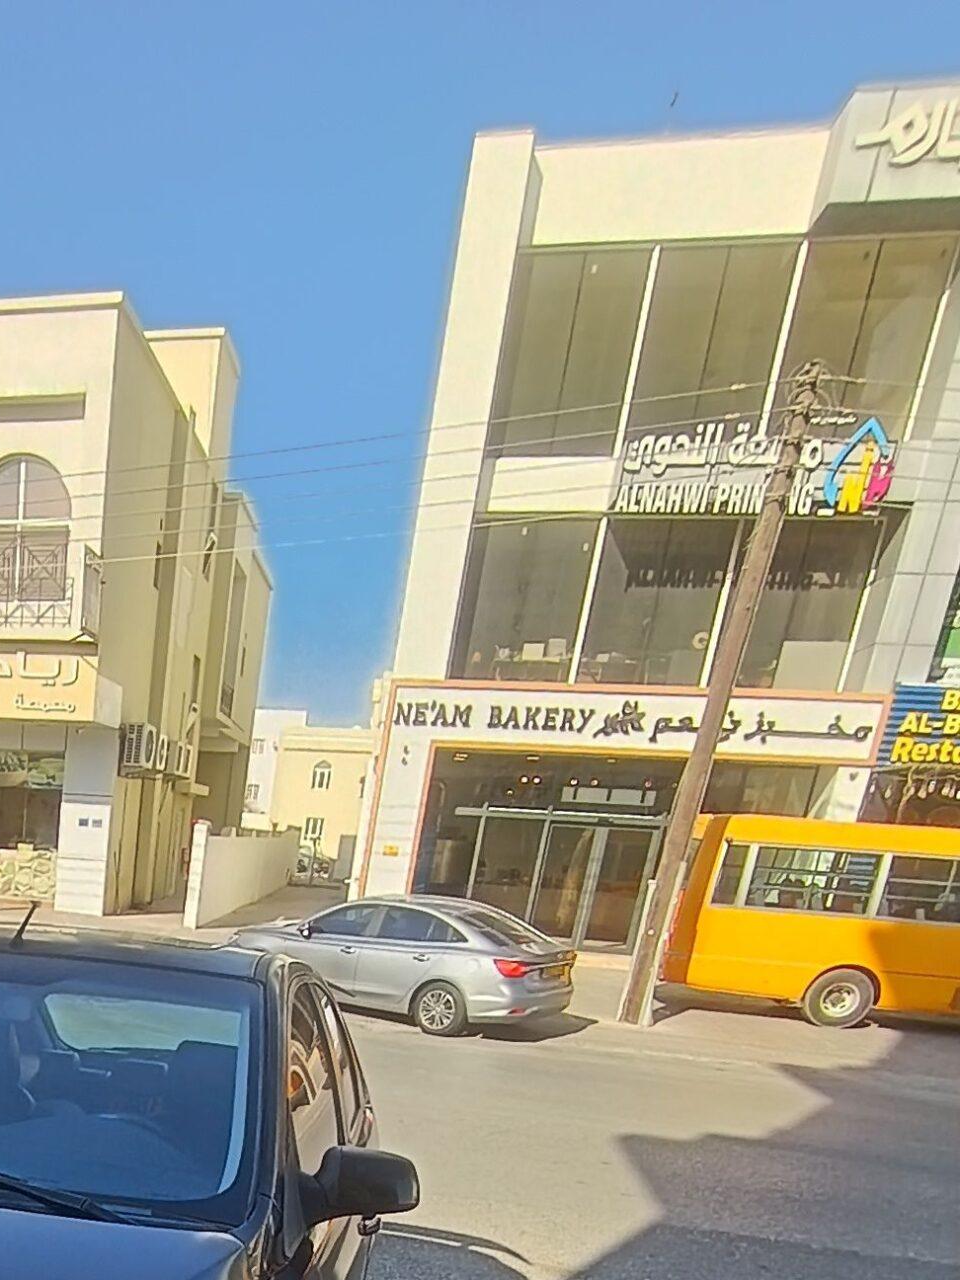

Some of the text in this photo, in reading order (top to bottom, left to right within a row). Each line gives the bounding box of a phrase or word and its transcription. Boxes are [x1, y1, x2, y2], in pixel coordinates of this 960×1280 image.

[727, 421, 824, 470] مبعة
[614, 480, 815, 515] ALNAHWI PRINNG
[394, 700, 596, 734] NE'AM BAKERY
